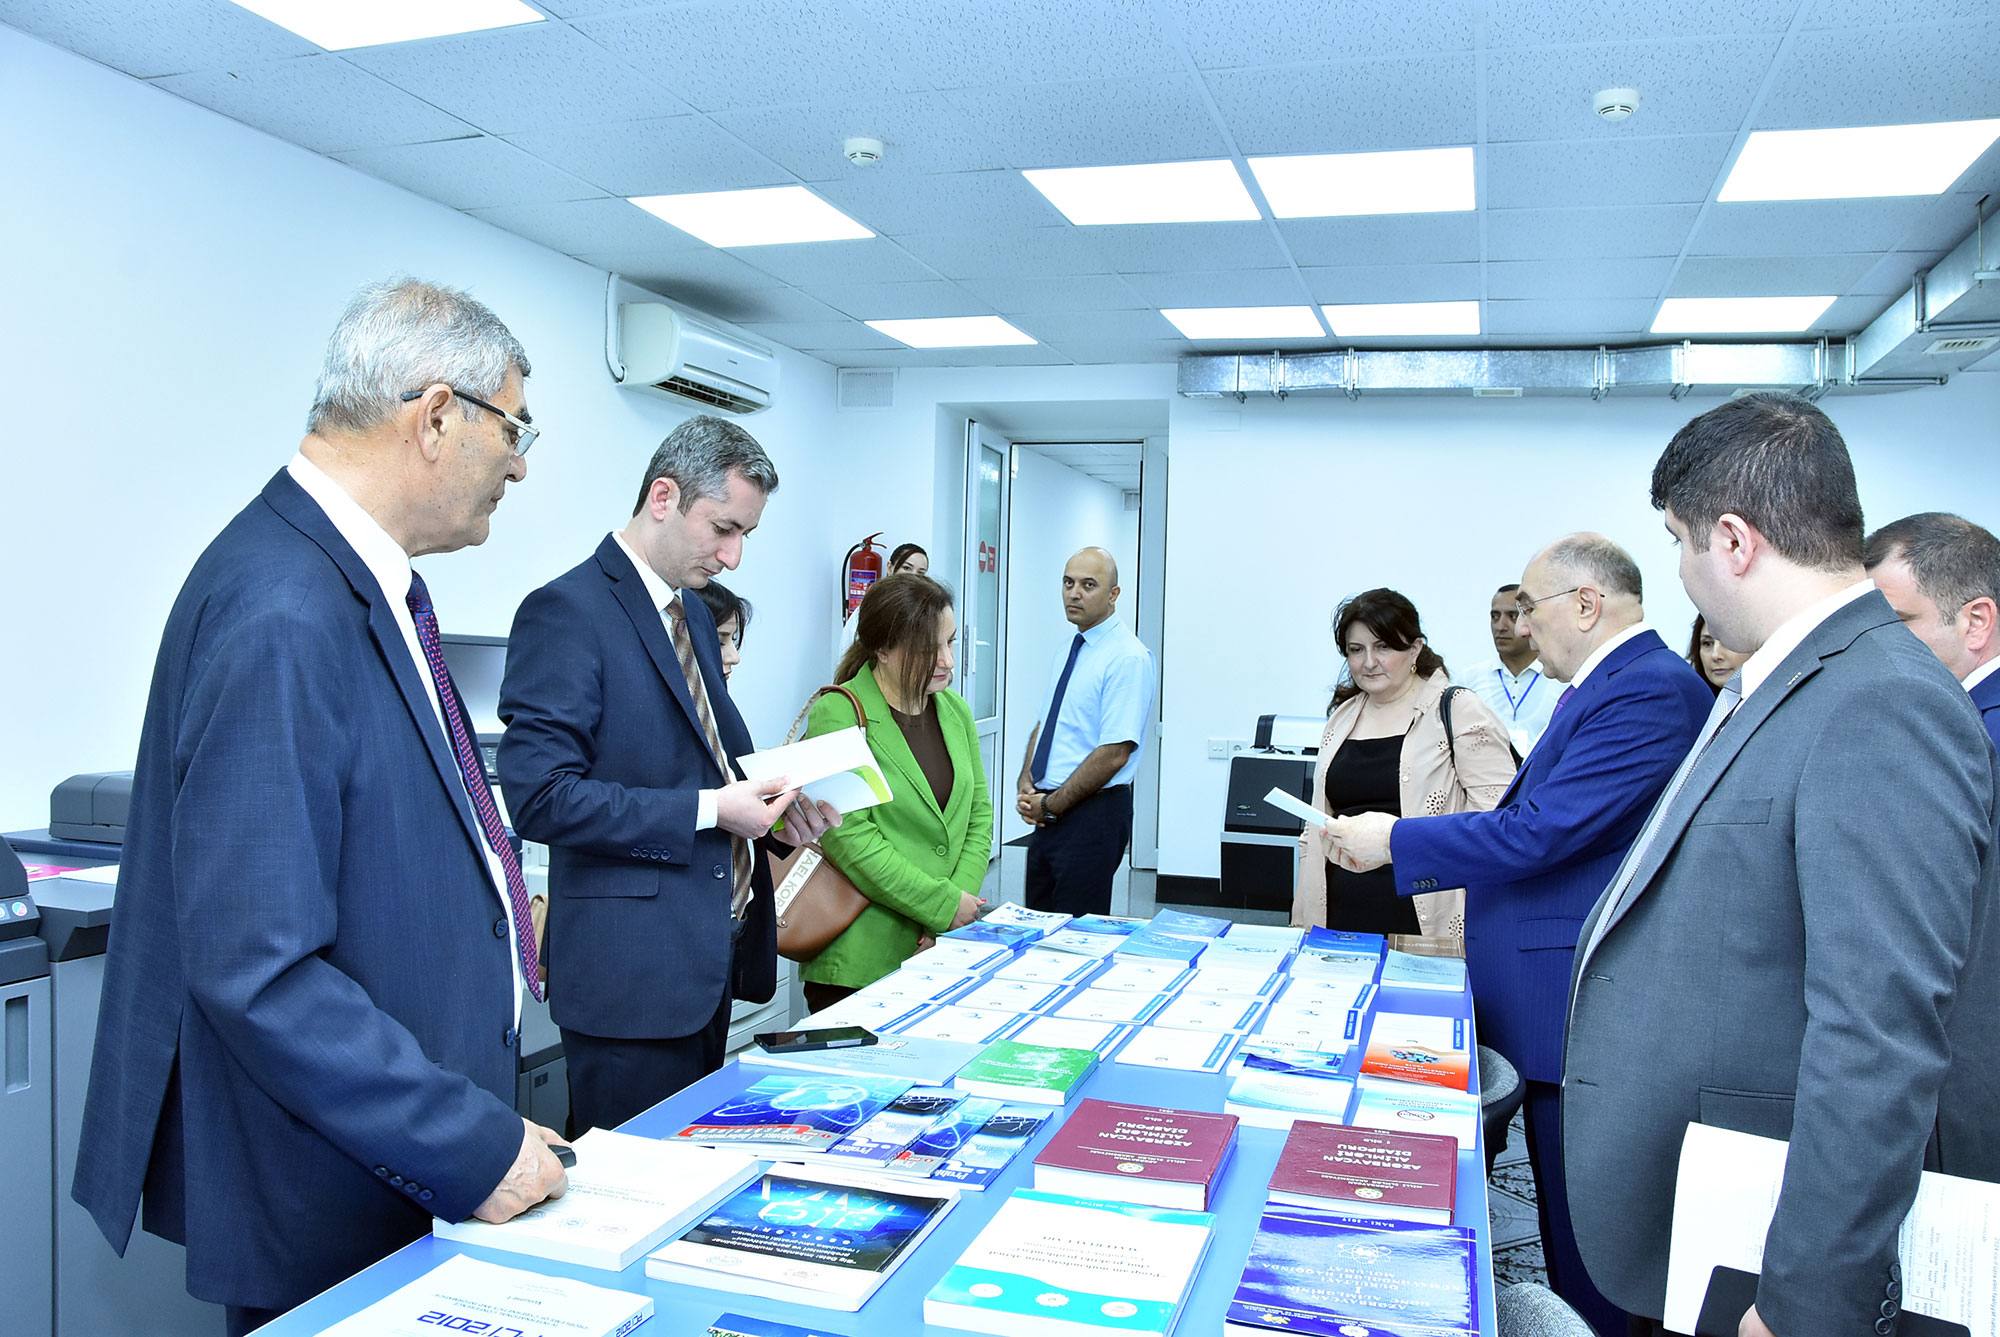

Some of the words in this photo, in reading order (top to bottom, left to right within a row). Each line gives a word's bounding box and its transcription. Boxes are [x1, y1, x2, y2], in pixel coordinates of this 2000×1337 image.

[1112, 1127, 1184, 1140] ALİMLƏRİ
[1114, 1120, 1188, 1134] DİASPORU
[1096, 1131, 1193, 1147] AZƏRBAYCAN
[1335, 1143, 1412, 1157] DİASPORU
[1335, 1150, 1410, 1163] ALİMLƏRİ
[1321, 1154, 1421, 1171] AZƏRBAYCAN
[758, 1200, 889, 1232] BIG
